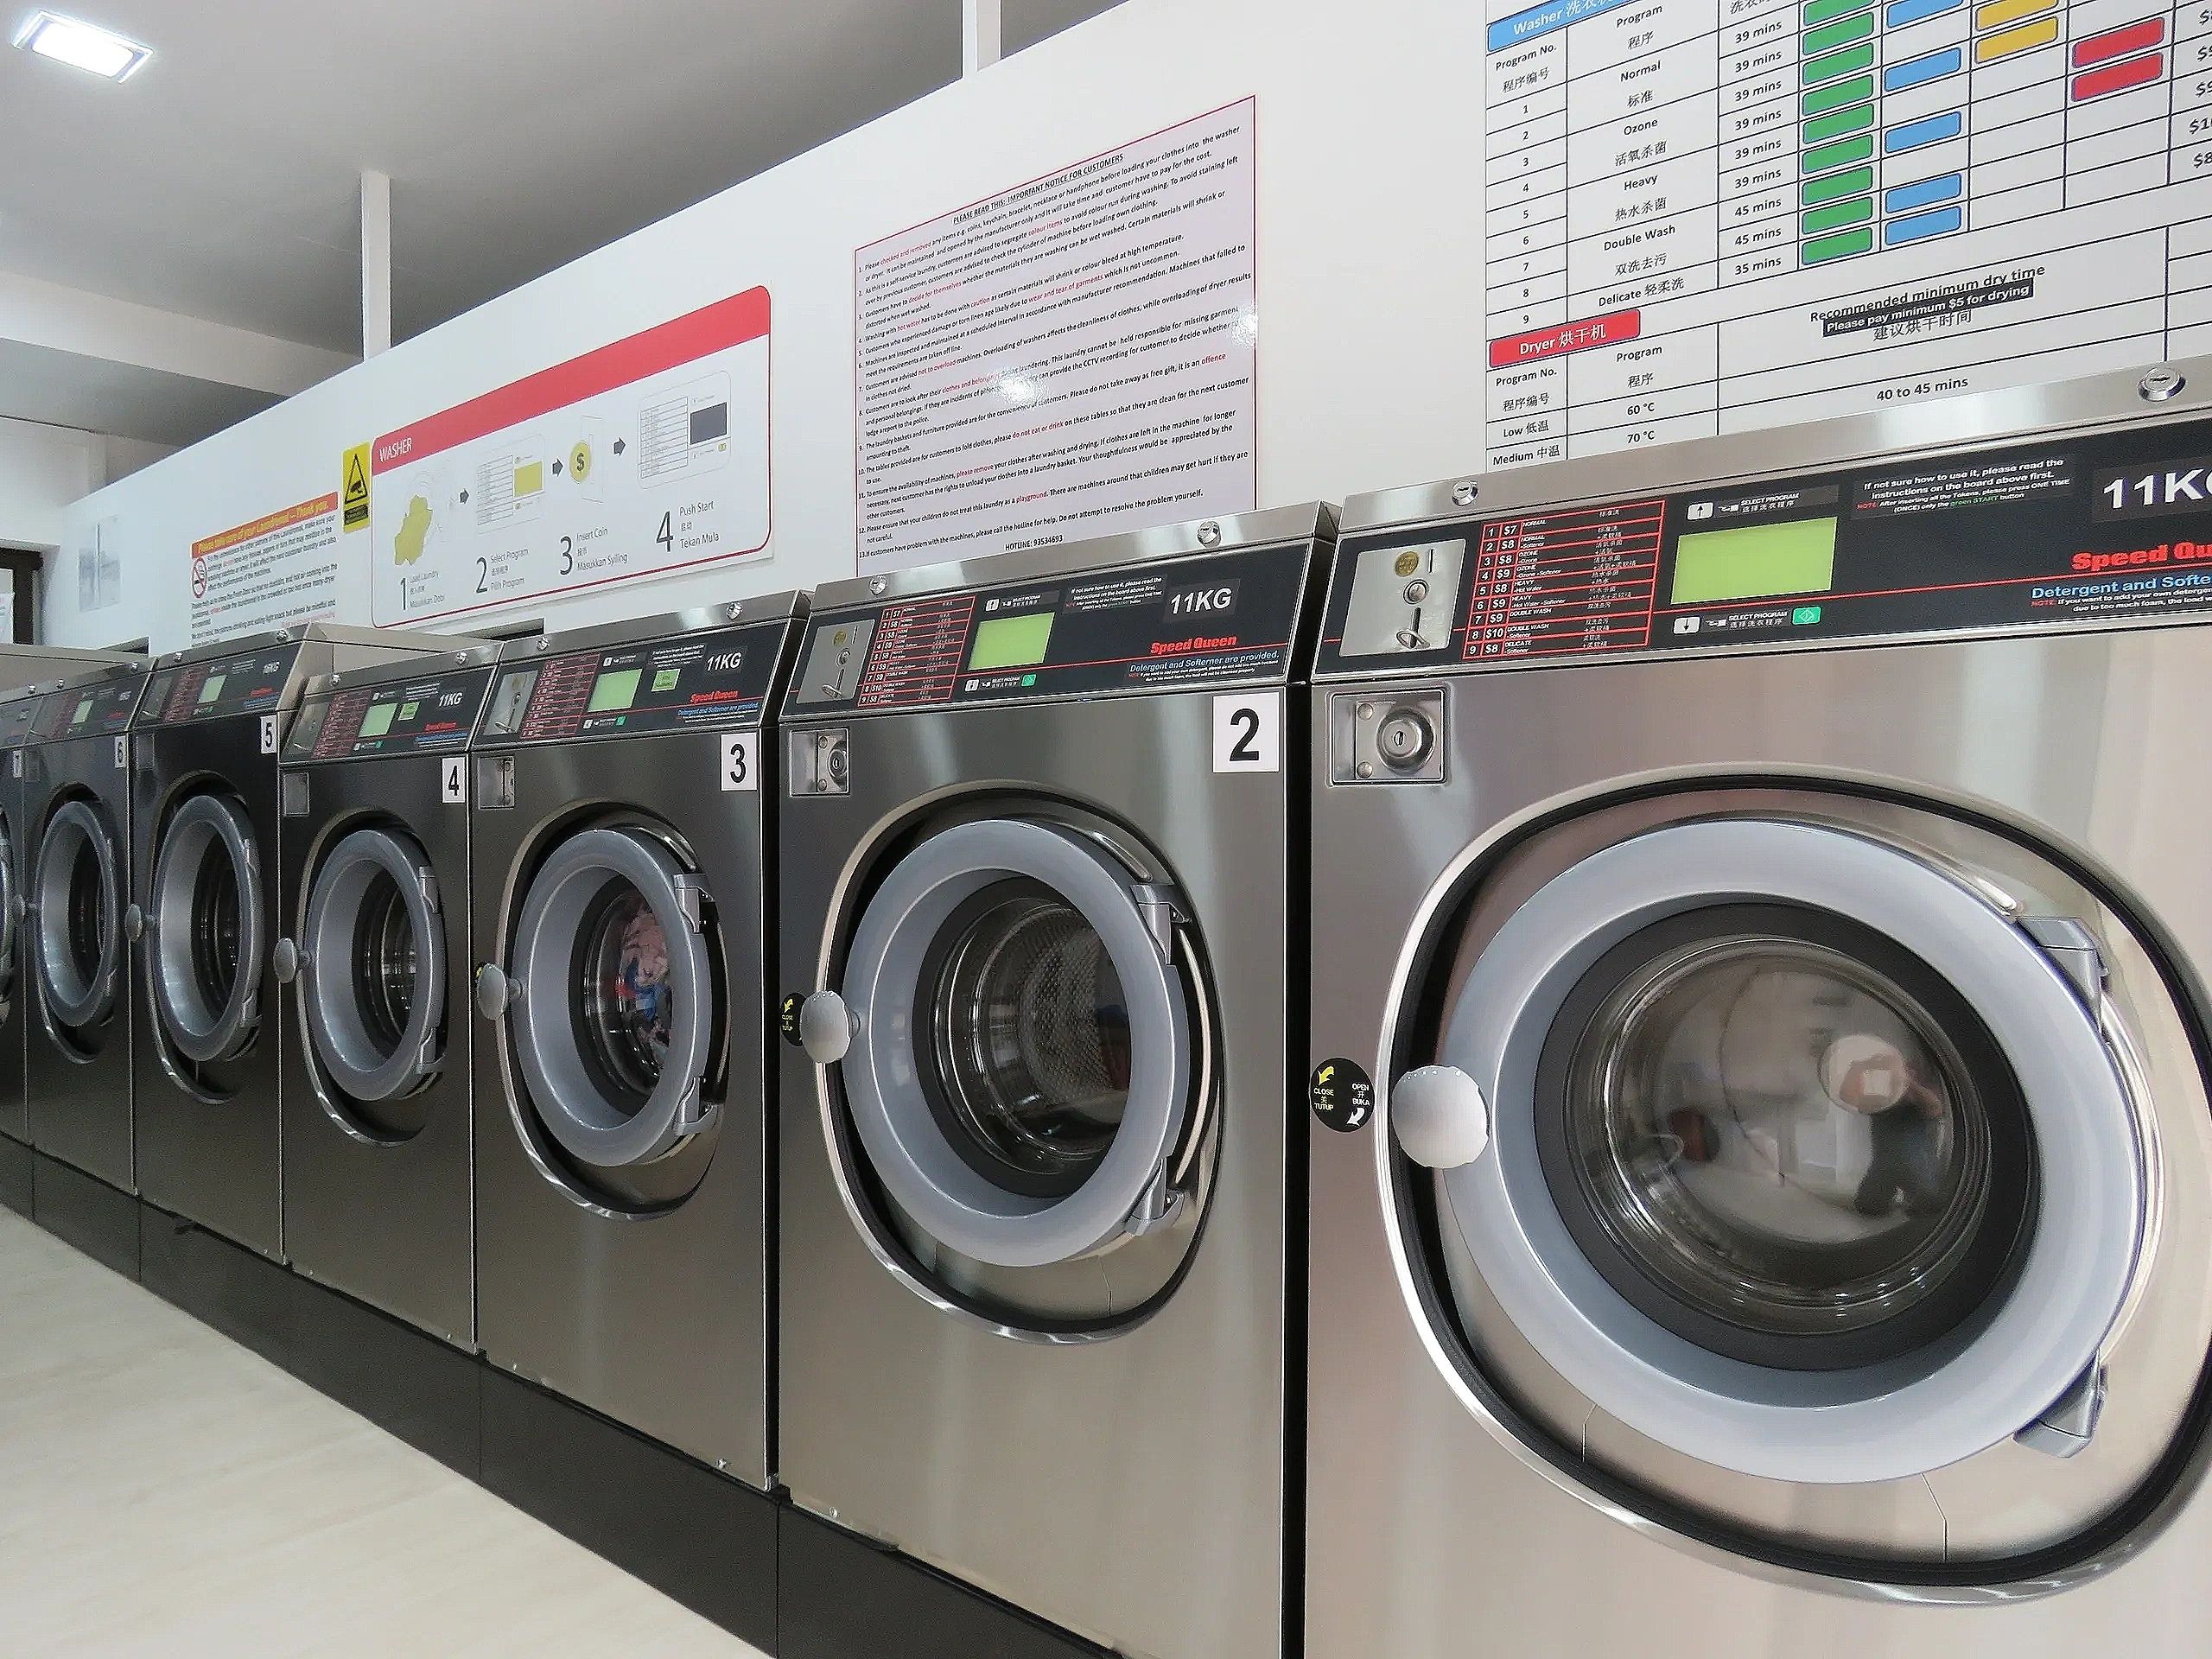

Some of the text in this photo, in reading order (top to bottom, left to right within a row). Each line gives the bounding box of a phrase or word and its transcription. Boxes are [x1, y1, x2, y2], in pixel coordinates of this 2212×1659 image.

[1513, 10, 1562, 35] Washer
[1616, 5, 1662, 29] Program
[1628, 31, 1654, 49] 程序
[1735, 21, 1782, 44] 39 mins
[1496, 43, 1556, 71] Program No.
[1735, 50, 1782, 73] 39 mins
[1502, 67, 1549, 93] 程序编号
[1620, 60, 1662, 83] Normal
[1523, 105, 1529, 114] 1
[1627, 91, 1653, 107] 标准
[1522, 130, 1529, 140] 2
[1624, 118, 1658, 136] Ozone
[1146, 127, 1240, 168] your clothes into the washer
[1615, 141, 1667, 167] 活氧杀菌
[1522, 157, 1529, 167] 3
[2193, 152, 2212, 168] $8
[953, 154, 1123, 225] PLEASE READ THIS: IMPORTANT NOTICE FOR CUSTOMERS
[1522, 183, 1529, 193] 4
[1624, 174, 1658, 192] Heavy
[1522, 210, 1529, 219] 5
[1615, 197, 1667, 222] 热水杀菌
[1735, 198, 1782, 218] 45 mins
[1522, 236, 1529, 245] 6
[1604, 224, 1675, 251] Double Wash
[1735, 226, 1782, 247] 45 mins
[1523, 263, 1529, 271] 7
[1615, 253, 1667, 276] 双洗去污
[1735, 256, 1782, 276] 35 mins
[1522, 288, 1529, 298] 8
[1599, 278, 1684, 307] Delicate 轻柔洗
[1810, 265, 2046, 322] Recommended minimum dry time
[1523, 315, 1529, 324] 9
[1827, 285, 2030, 333] Please pay minimum $5 for drying
[1872, 310, 1973, 341] 建议烘干时间
[1520, 324, 1606, 356] Dryer 烘干机
[1877, 377, 1968, 402] 40 to 45 mins
[1627, 402, 1655, 416] 60 °C
[1503, 420, 1549, 437] Low 低温
[1627, 430, 1655, 444] 70 °C
[379, 437, 413, 462] WASHER
[1493, 444, 1560, 467] Medium 中温
[576, 453, 584, 471] $
[1949, 471, 1967, 480] use
[1982, 465, 2018, 477] please
[2019, 461, 2044, 470] read
[1872, 487, 1929, 499] instructions
[1964, 479, 1993, 488] board
[2030, 471, 2054, 480] first.
[2103, 467, 2212, 509] 11K
[680, 501, 714, 516] Push Start
[1079, 508, 1103, 518] attempt
[1111, 503, 1134, 512] resolve
[1147, 495, 1173, 507] problem
[1174, 488, 1204, 502] yourself.
[1741, 493, 1800, 506] SELECT PROGRAM
[576, 527, 608, 542] Insert Coin
[656, 511, 673, 552] 4
[680, 532, 719, 549] Tekan Mula
[1503, 525, 1516, 535] $7
[1005, 535, 1063, 550] HOTLINE: 93534693
[1502, 540, 1514, 550] $8
[560, 537, 573, 575] 3
[2072, 544, 2168, 571] Speed
[476, 557, 487, 593] 2
[400, 578, 406, 610] 1
[1495, 583, 1507, 593] $8
[2031, 578, 2156, 599] Detergent and
[1171, 588, 1232, 614] 11KG
[1490, 613, 1503, 622] $9
[1486, 629, 1503, 639] $10
[1151, 636, 1236, 655] Speed Queen
[1485, 644, 1498, 653] $8
[707, 652, 741, 671] 11KG
[1130, 664, 1167, 672] Detergent
[1225, 654, 1238, 663] are
[1240, 651, 1279, 663] provided.
[438, 691, 462, 707] 11KG
[265, 721, 273, 748] 5
[1230, 709, 1260, 761] 2
[118, 740, 124, 763] 6
[730, 744, 747, 784] 3
[448, 765, 459, 796] 4
